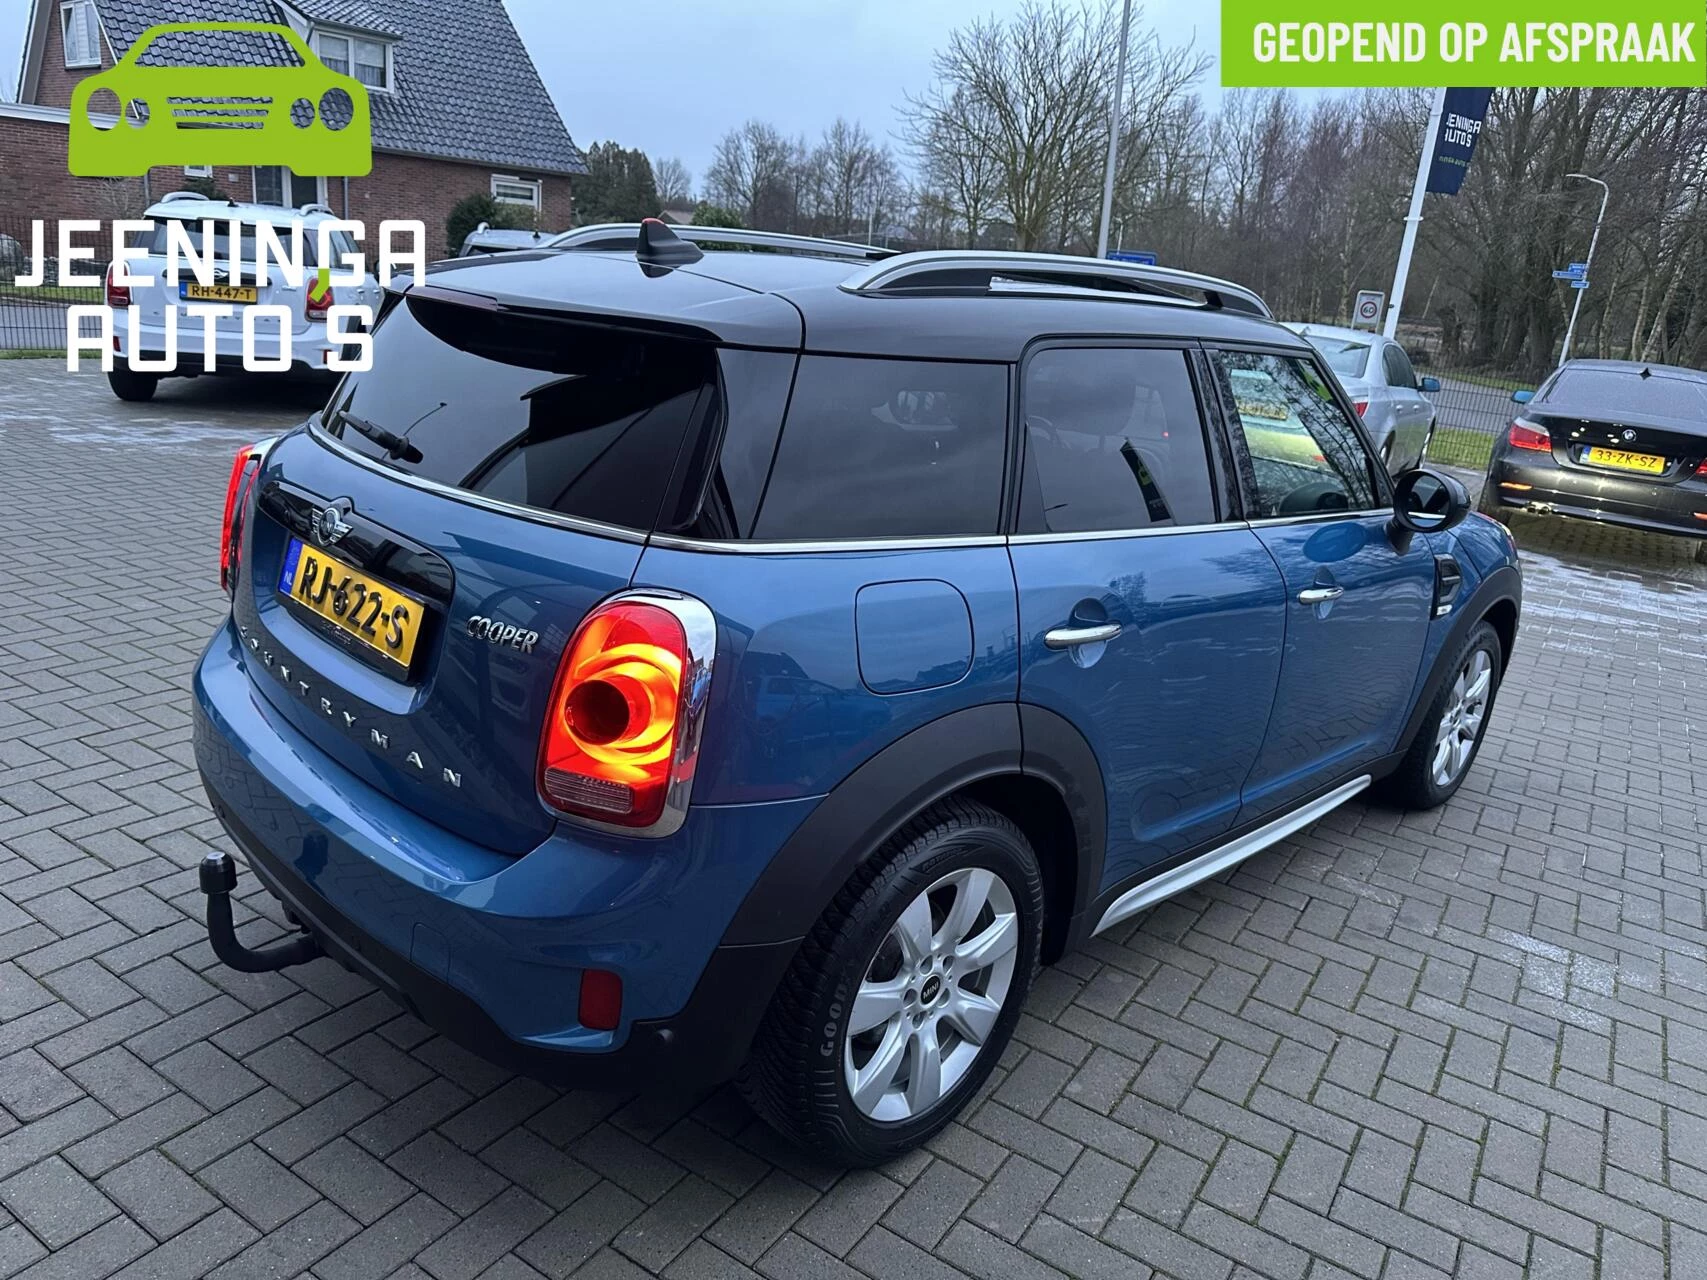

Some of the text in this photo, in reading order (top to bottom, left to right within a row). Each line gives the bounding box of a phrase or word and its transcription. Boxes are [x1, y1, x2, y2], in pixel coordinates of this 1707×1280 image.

[192, 286, 252, 299] RH-447-T
[1363, 306, 1374, 314] 60
[1596, 449, 1657, 468] 33-ZK-SZ
[299, 556, 410, 649] RJ-622-S
[466, 615, 539, 654] COOPER
[239, 626, 463, 788] COUNTRYMAN
[923, 981, 939, 999] MINI
